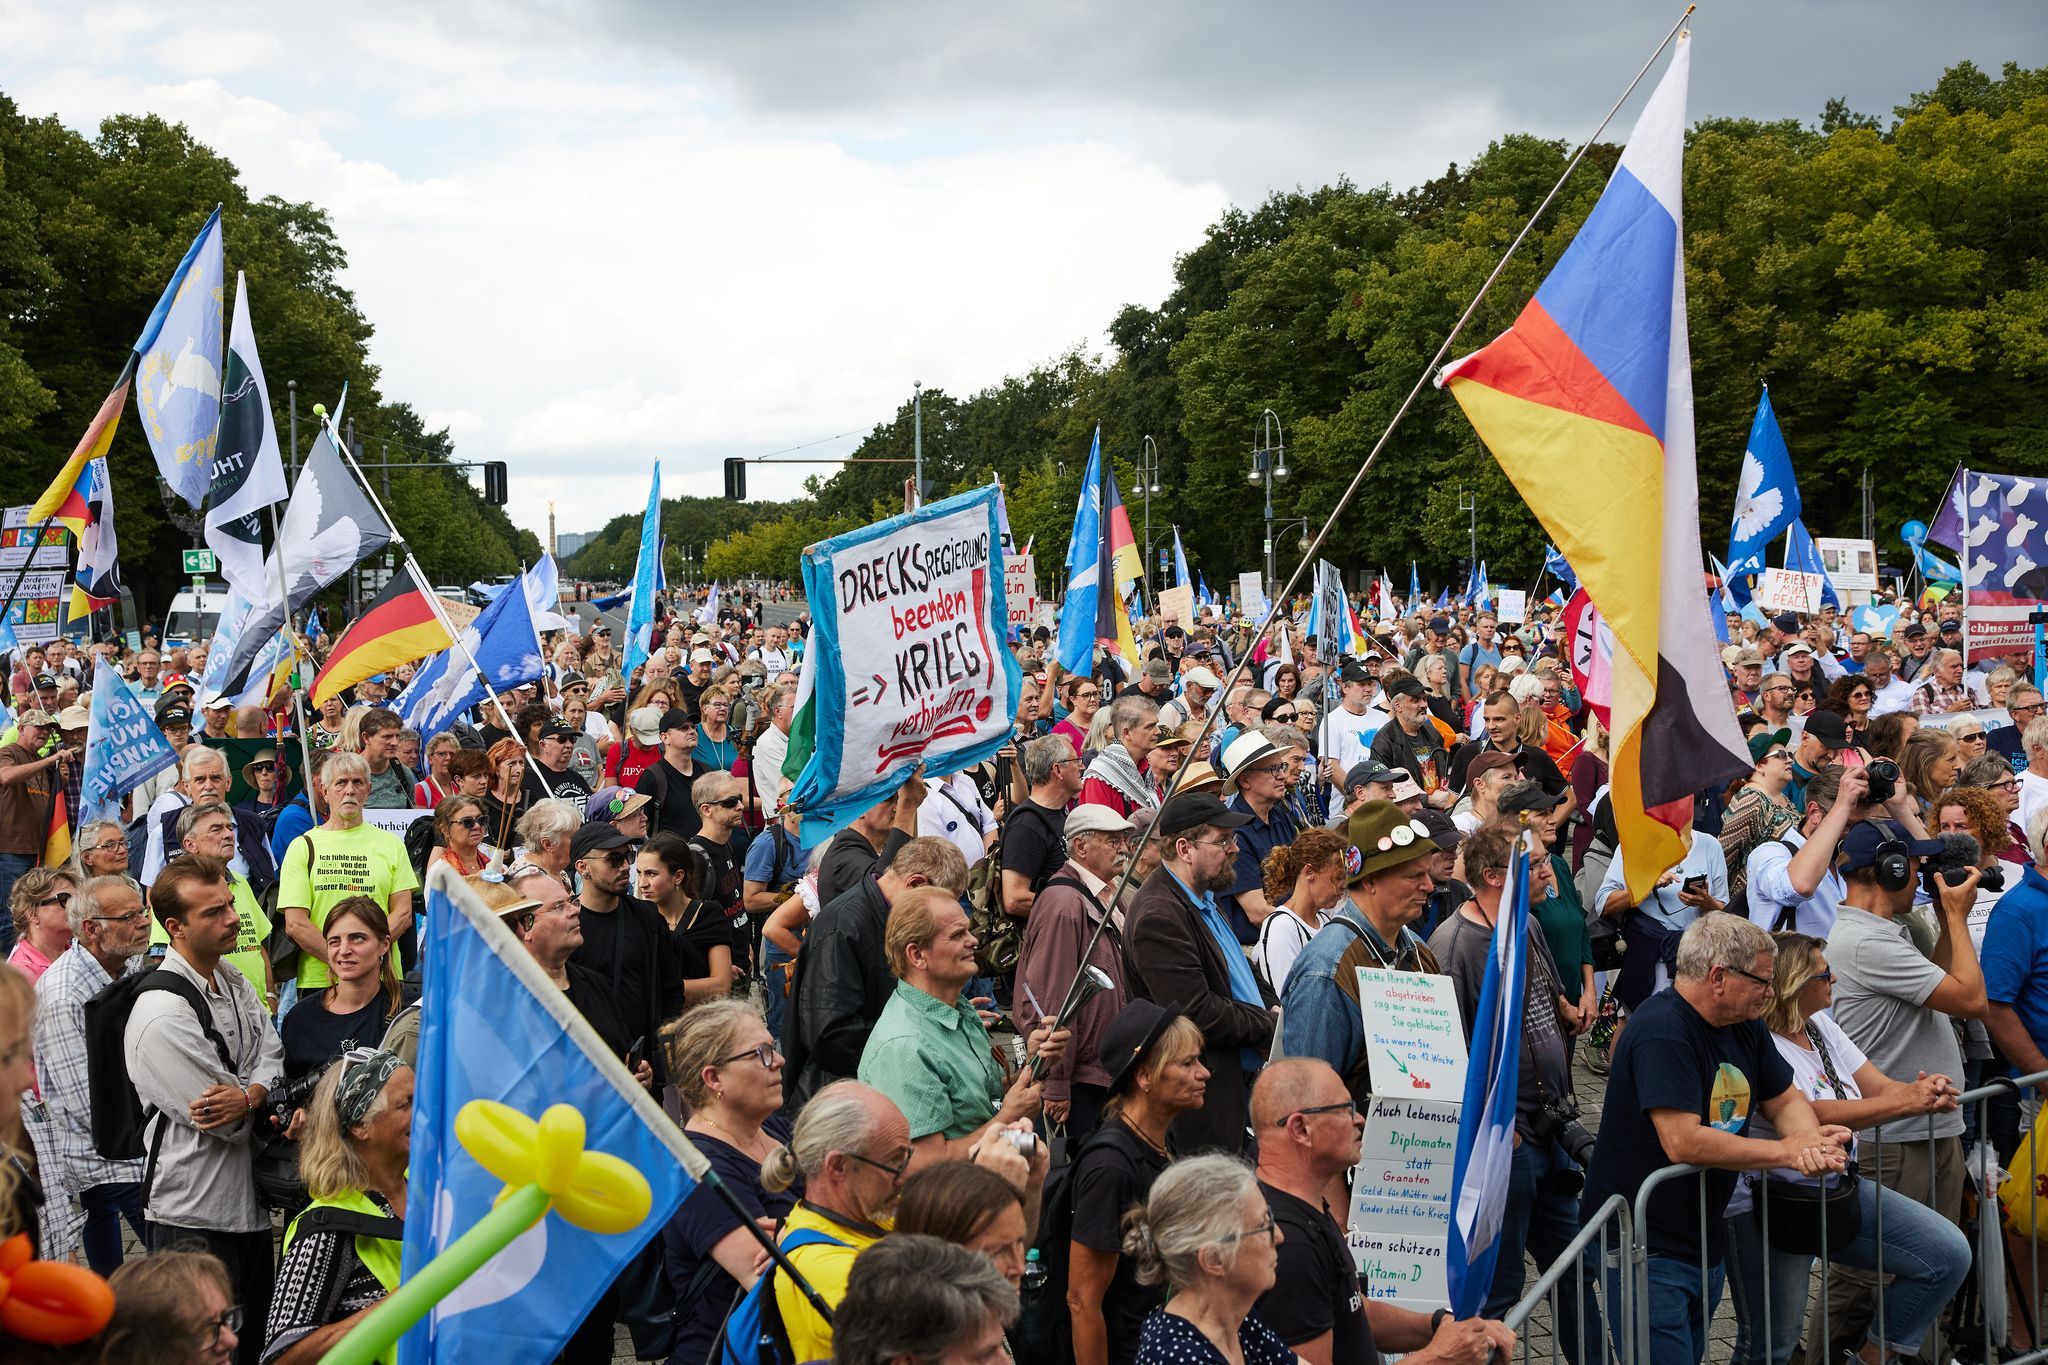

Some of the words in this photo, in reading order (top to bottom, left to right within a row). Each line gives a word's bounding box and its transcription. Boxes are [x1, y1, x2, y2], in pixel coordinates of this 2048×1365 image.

[22, 576, 51, 584] ordern
[1014, 577, 1025, 593] in
[1775, 572, 1819, 588] FRIEDEN
[1773, 593, 1809, 609] PEACE
[890, 588, 967, 640] beenden
[2013, 622, 2034, 632] mit
[895, 622, 981, 707] KRIEG
[890, 687, 976, 742] verhindern
[622, 767, 645, 777] ДРУ
[344, 869, 370, 877] bedroht
[314, 884, 338, 892] unserer
[1386, 972, 1405, 984] Ihre
[1385, 987, 1435, 1003] abgetrieben
[1373, 1000, 1389, 1011] sag
[1423, 1006, 1449, 1017] wären
[1391, 1015, 1405, 1027] Sie
[1373, 1034, 1389, 1044] Das
[1392, 1039, 1417, 1047] waren
[1407, 1052, 1418, 1060] ca.
[1421, 1052, 1429, 1060] 12
[1431, 1054, 1455, 1065] Woche
[1372, 1101, 1401, 1118] Auch
[1390, 1130, 1452, 1154] Diplomaten
[1405, 1157, 1432, 1170] statt
[1383, 1170, 1430, 1184] Granaten
[1361, 1185, 1382, 1195] Geld
[1388, 1187, 1400, 1197] für
[1401, 1189, 1429, 1199] Mütter
[1433, 1193, 1447, 1202] und
[1360, 1201, 1383, 1213] Kinder
[1386, 1206, 1409, 1215] statt
[1412, 1206, 1425, 1216] für
[1428, 1206, 1450, 1224] Krieg
[1351, 1234, 1383, 1250] Leben
[1388, 1238, 1441, 1257] schützen
[1362, 1259, 1407, 1281] Vitamin
[1410, 1264, 1422, 1282] D
[1366, 1285, 1397, 1298] statt
